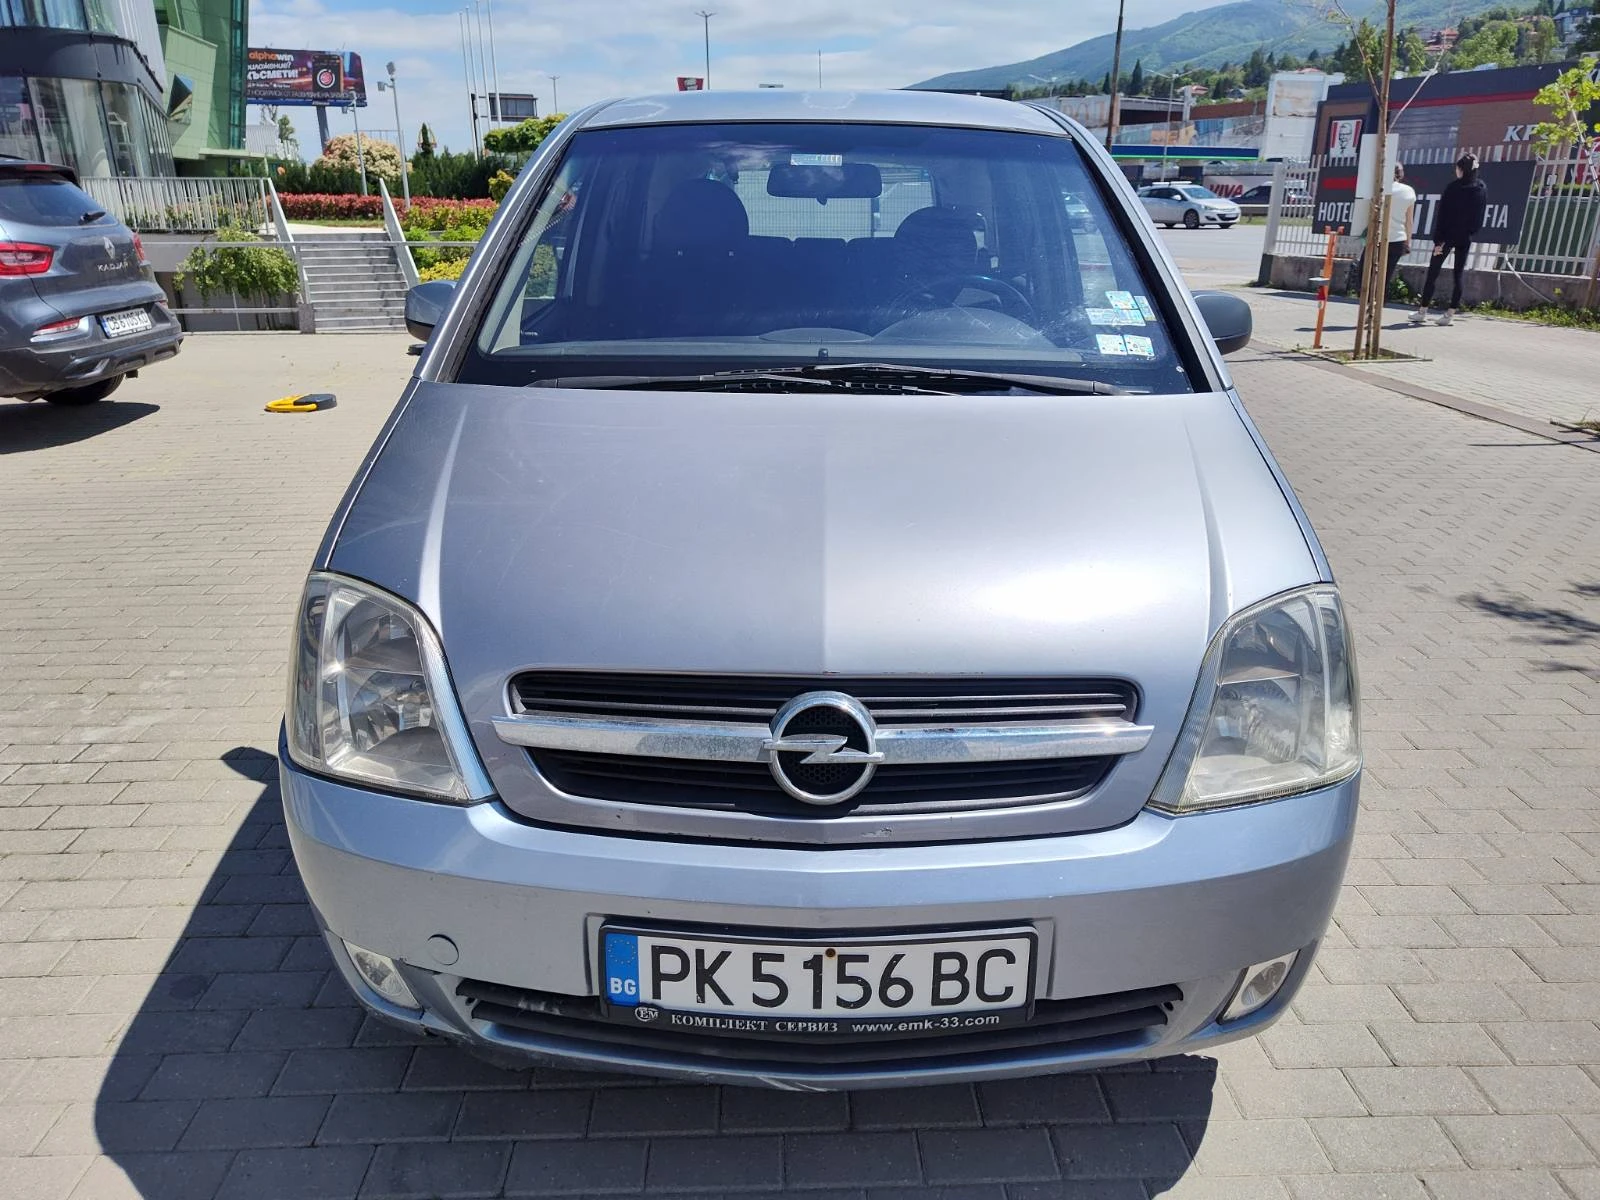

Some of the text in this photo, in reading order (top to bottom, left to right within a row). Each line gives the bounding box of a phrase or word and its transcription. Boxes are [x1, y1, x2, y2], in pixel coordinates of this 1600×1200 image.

[248, 51, 294, 61] alphawin
[1210, 184, 1244, 198] VIVA
[1318, 202, 1354, 222] HOTEL
[97, 261, 129, 272] KADJAR
[610, 977, 637, 995] BG
[651, 945, 1016, 1010] PK 5156 BC
[671, 1014, 769, 1031] КОМПЛЕКТ
[775, 1021, 838, 1033] СЕРВИЗ
[852, 1014, 1000, 1032] www.emk-33.com
